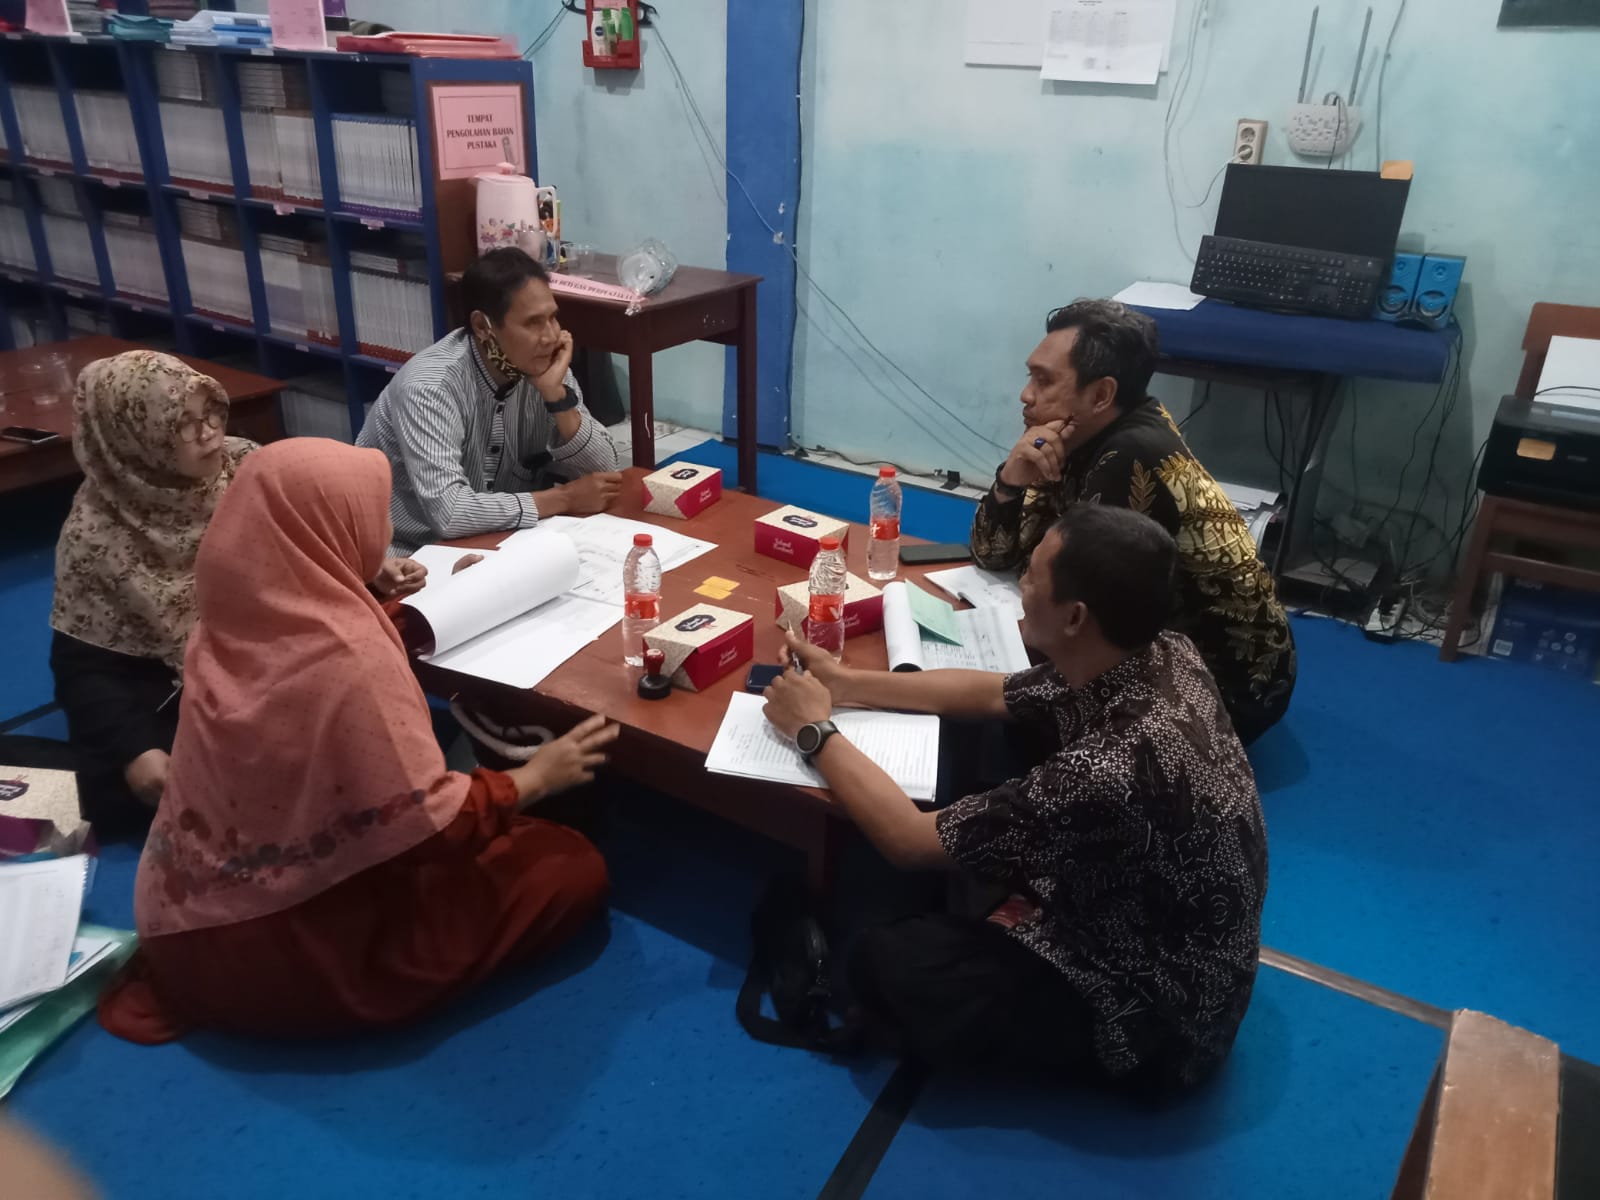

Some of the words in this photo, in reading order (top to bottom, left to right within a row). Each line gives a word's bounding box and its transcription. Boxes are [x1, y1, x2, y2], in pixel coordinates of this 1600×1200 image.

[467, 114, 493, 123] TEMPAT
[446, 128, 491, 138] PENGOLAHAN
[492, 127, 514, 136] BAHAN
[466, 141, 497, 150] PUSTAKA
